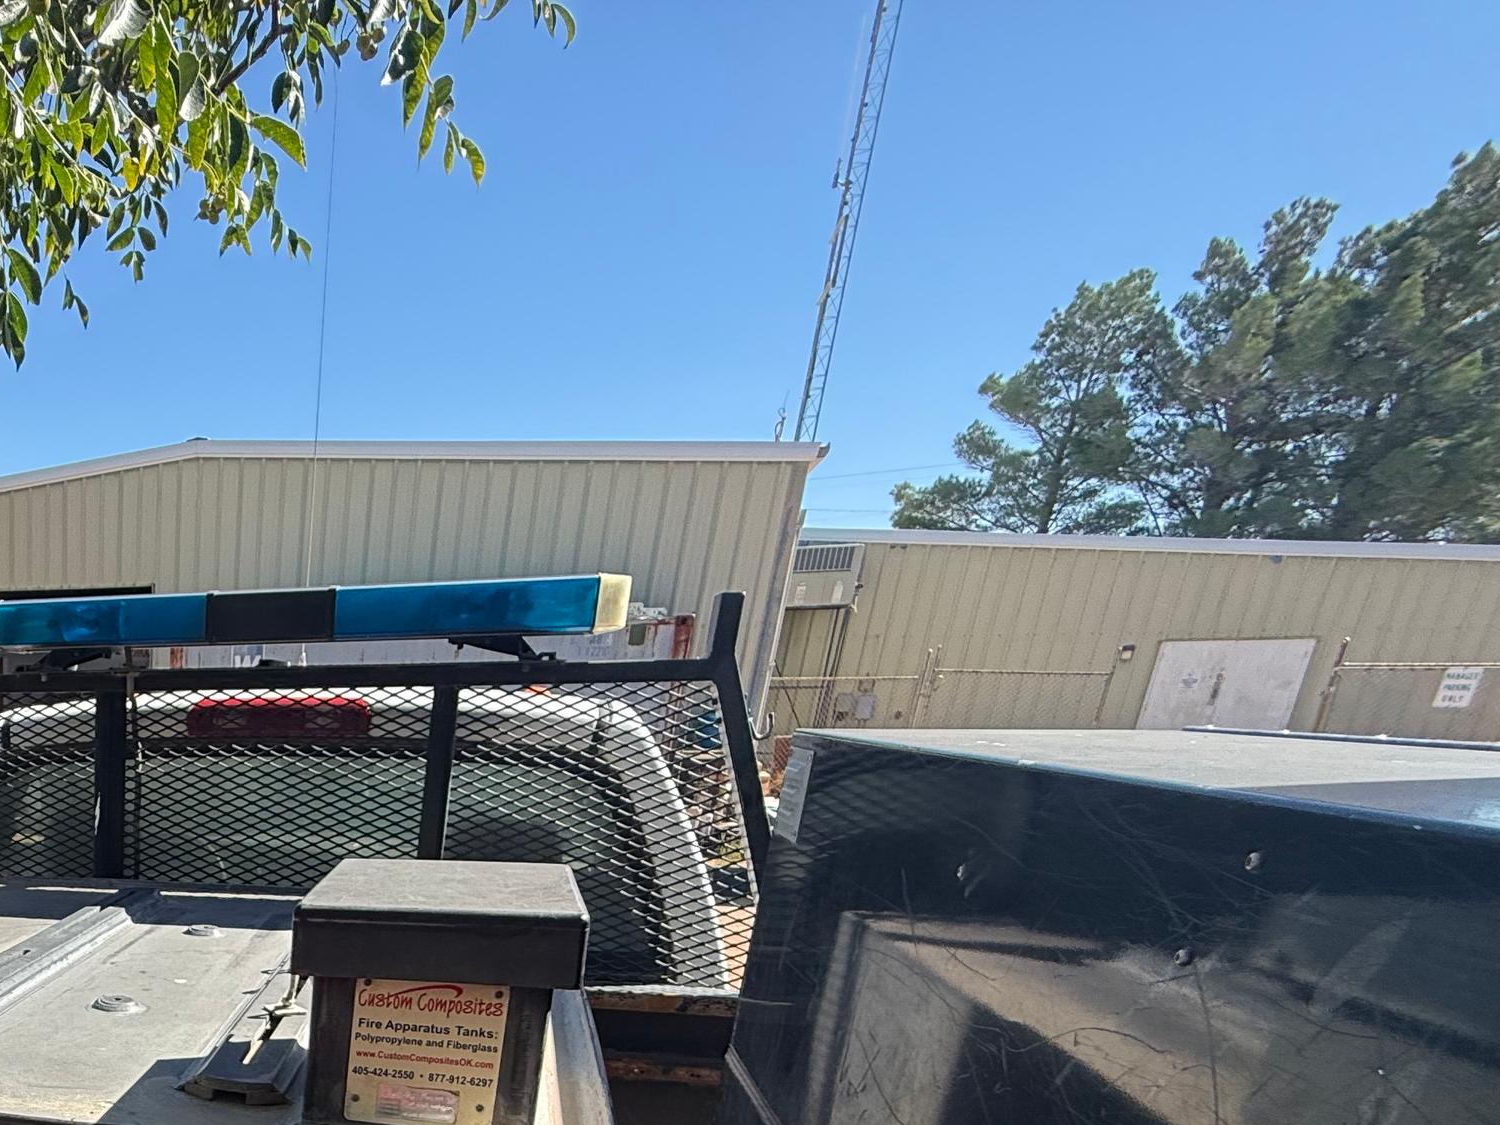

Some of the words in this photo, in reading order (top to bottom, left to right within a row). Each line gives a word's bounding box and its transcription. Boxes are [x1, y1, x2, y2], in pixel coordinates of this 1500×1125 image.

[358, 988, 413, 1010] Custom
[417, 992, 504, 1018] Composites
[357, 1017, 383, 1030] Fire
[385, 1020, 451, 1035] Apparatus
[455, 1025, 499, 1040] Tanks:
[354, 1032, 423, 1047] Polypropylene
[425, 1039, 444, 1048] and
[446, 1040, 499, 1054] Fiberglass
[355, 1050, 494, 1069] www.CustomCompositesOK.com
[351, 1066, 415, 1080] 405-424-2550
[428, 1072, 494, 1088] 877-912-6297
